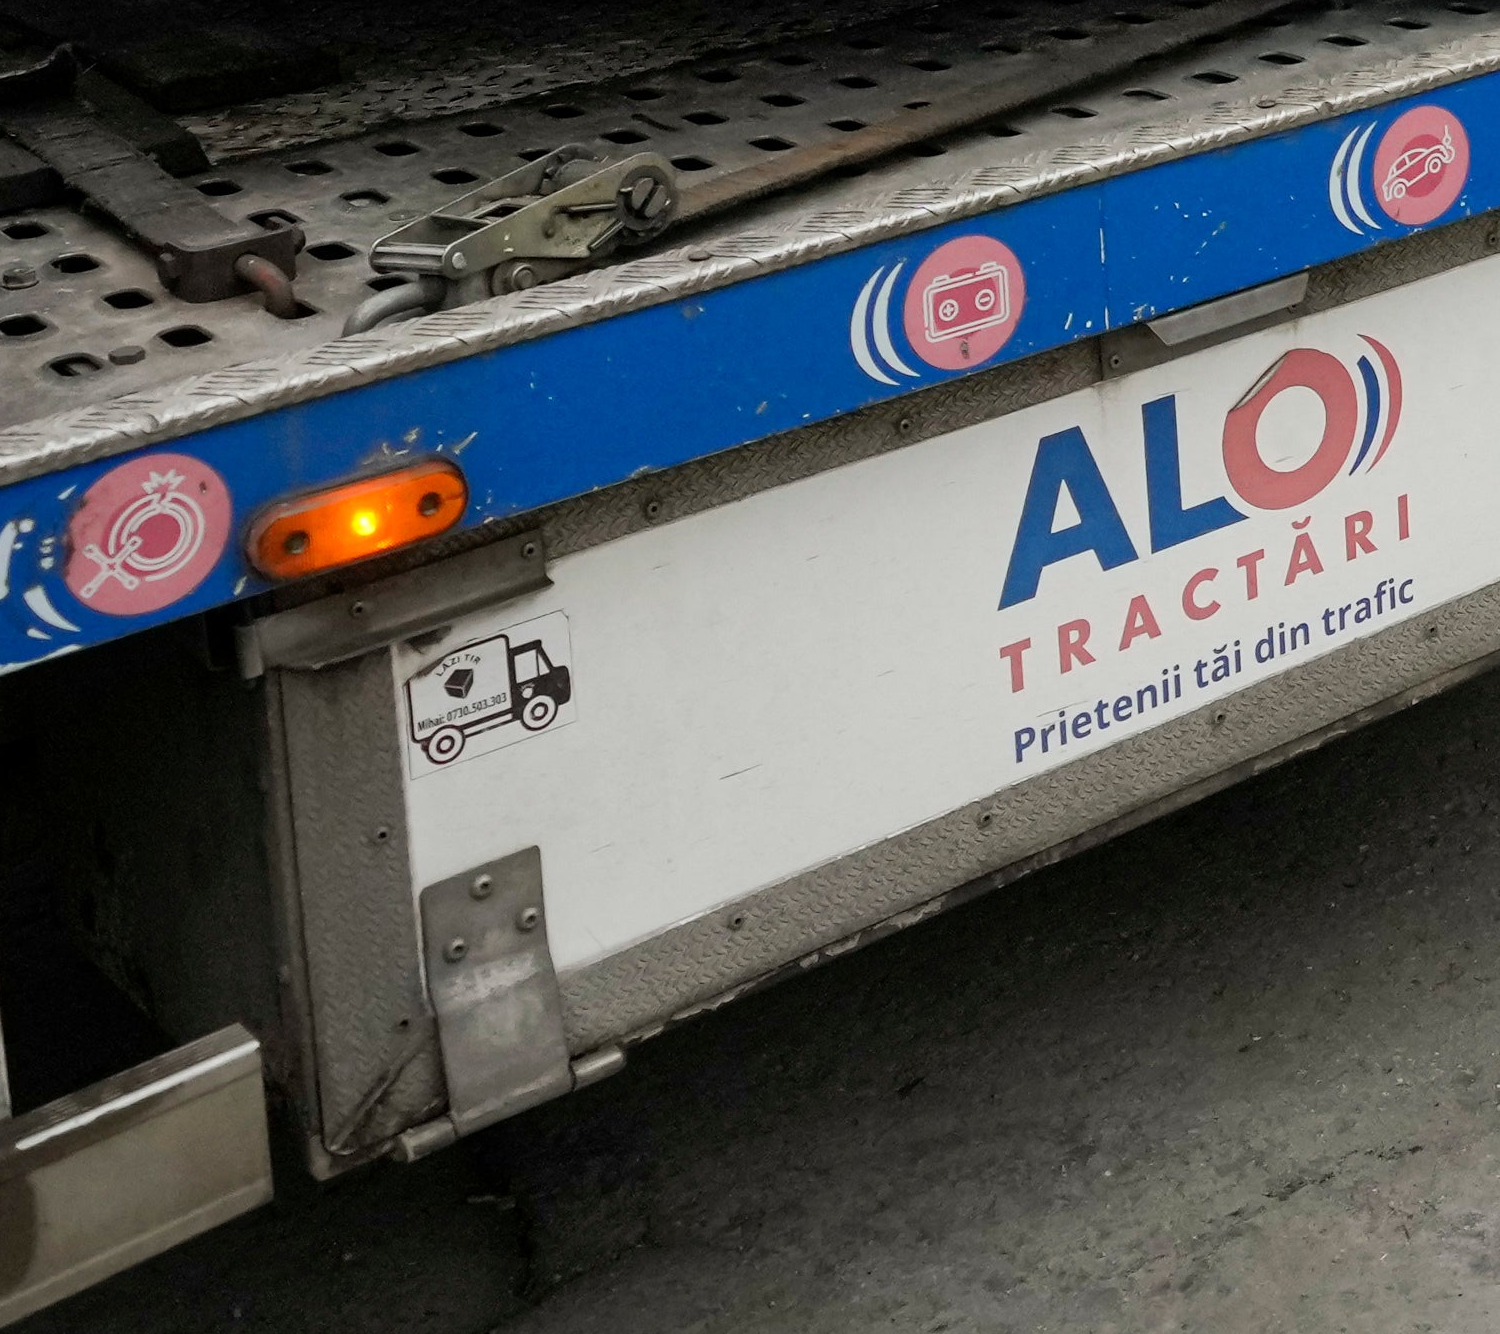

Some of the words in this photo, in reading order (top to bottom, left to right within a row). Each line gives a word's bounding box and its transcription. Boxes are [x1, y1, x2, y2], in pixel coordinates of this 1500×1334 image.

[997, 347, 1359, 612] ALO
[464, 653, 481, 665] TIR
[999, 493, 1412, 694] TRACTĂRI
[1012, 663, 1183, 765] Prietenii
[1193, 639, 1243, 689] tăi
[1253, 621, 1311, 666] din
[1320, 575, 1415, 638] trafic
